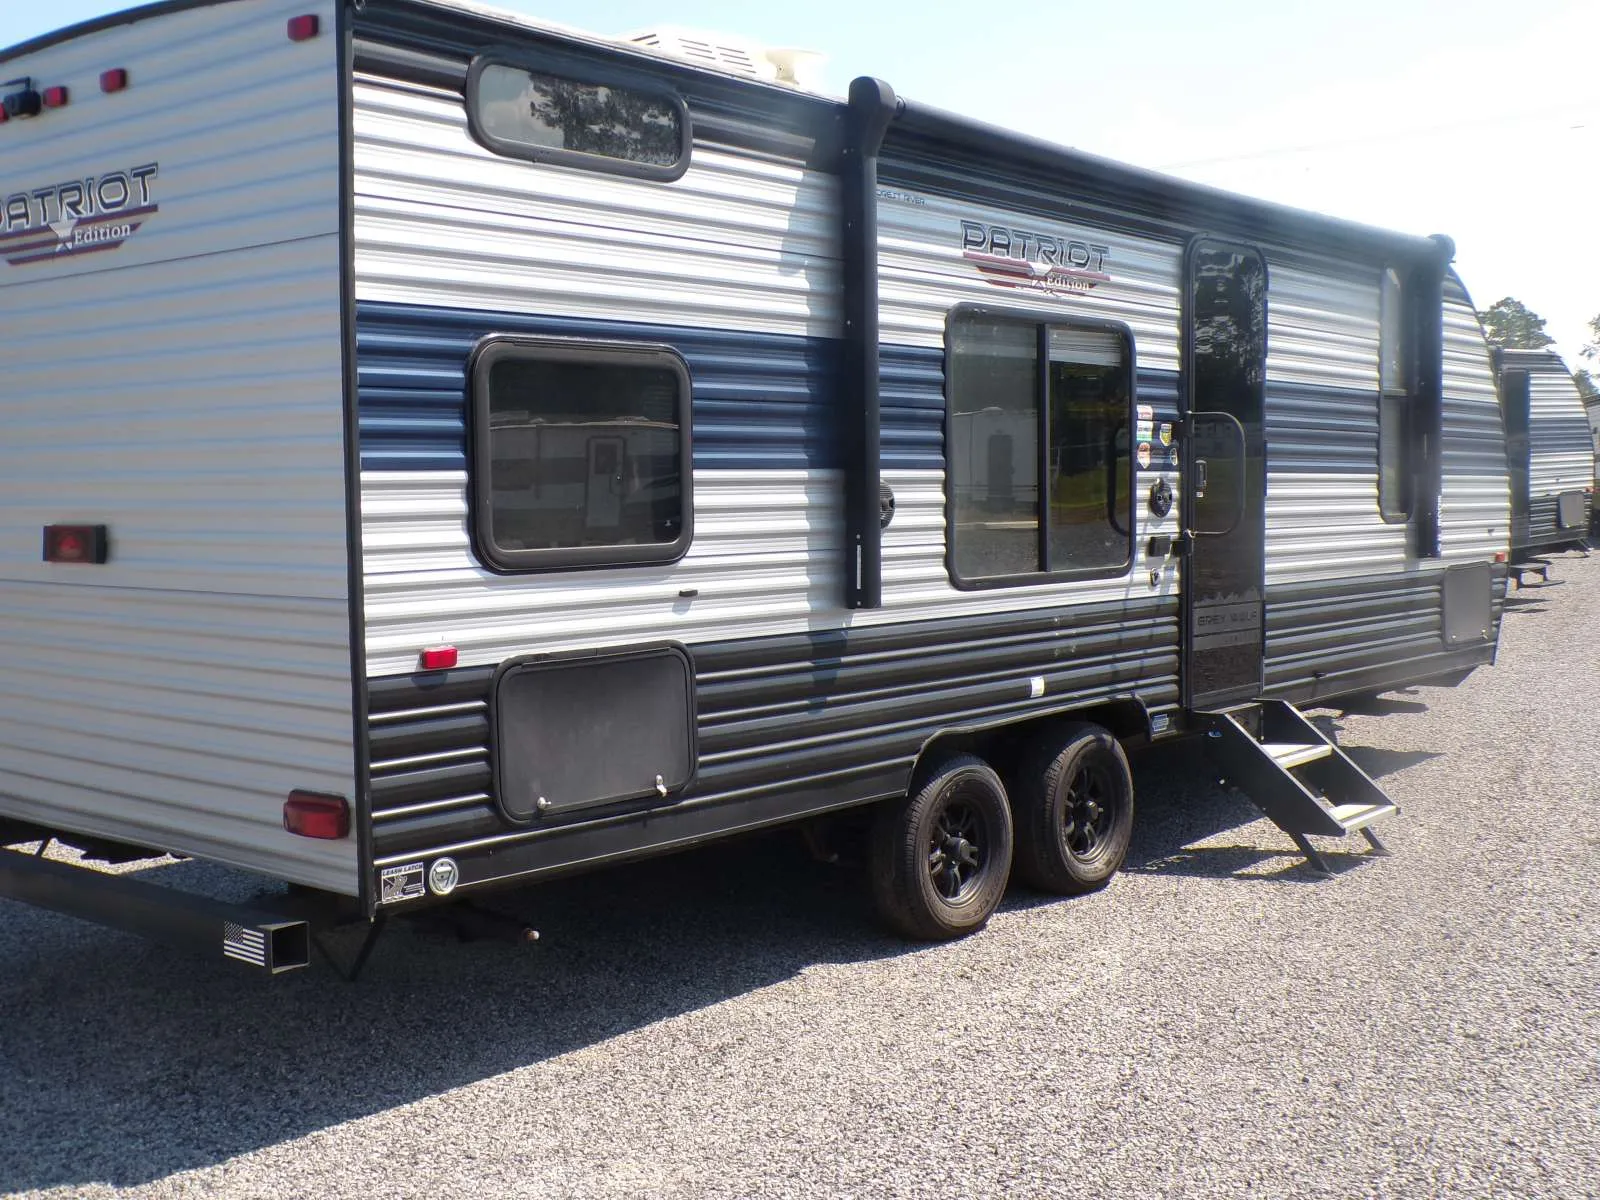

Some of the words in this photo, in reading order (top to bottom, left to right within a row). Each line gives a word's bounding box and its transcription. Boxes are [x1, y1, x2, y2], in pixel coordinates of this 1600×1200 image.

[0, 162, 158, 232] ATRIOT
[74, 223, 131, 245] Edition
[960, 220, 1111, 273] PATRIOT
[1045, 273, 1090, 292] Edition
